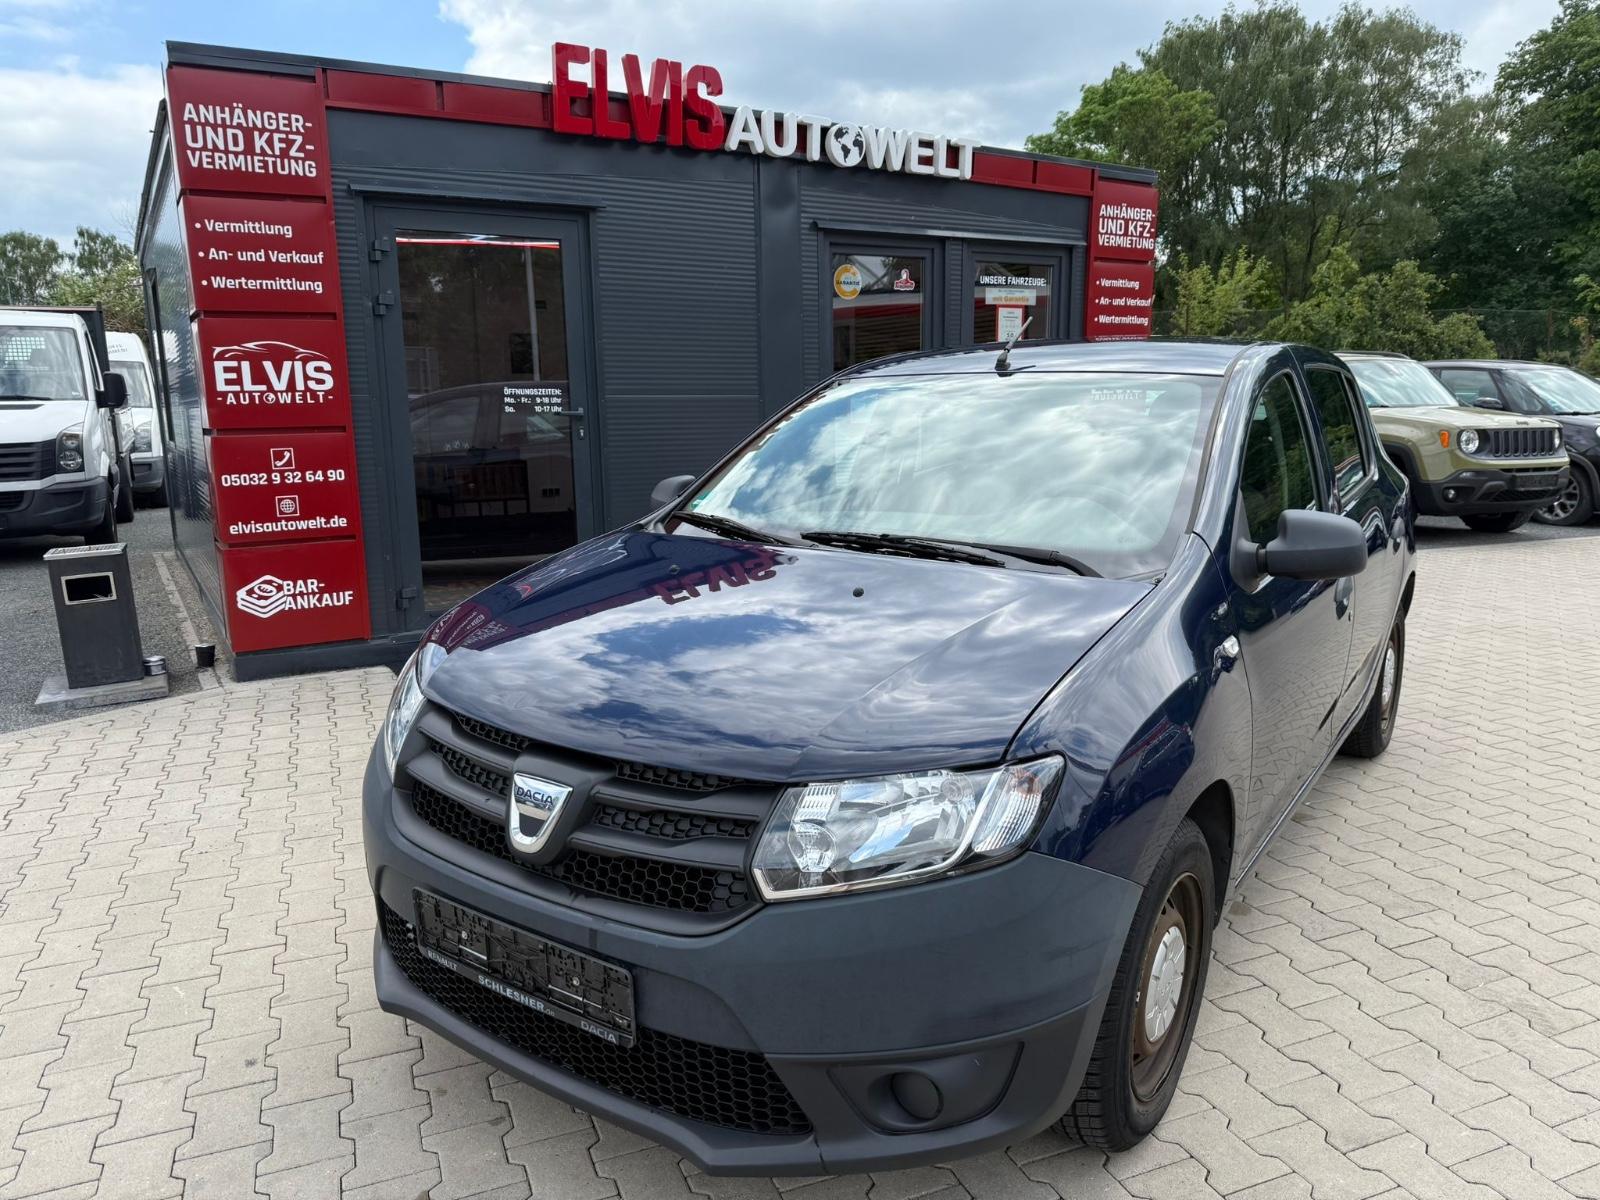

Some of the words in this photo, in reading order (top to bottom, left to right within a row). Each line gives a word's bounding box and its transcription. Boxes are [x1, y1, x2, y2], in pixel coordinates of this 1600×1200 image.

[183, 102, 312, 133] ANHÄNGER-
[552, 41, 725, 151] ELVIS
[724, 105, 981, 182] AUTOWELT
[184, 125, 245, 150] UND
[254, 131, 315, 157] KFZ-
[186, 150, 317, 178] VERMIETUNG
[1099, 203, 1155, 221] ANHÄNGER-
[204, 219, 293, 238] Vermittlung
[1099, 218, 1125, 235] UND
[1128, 221, 1155, 237] KFZ-
[1098, 234, 1154, 250] VERMIETUNG
[208, 247, 234, 260] An-
[238, 248, 265, 262] und
[269, 250, 324, 265] Verkauf
[211, 275, 323, 294] Wertermittlung
[980, 275, 1006, 285] UNSERE
[1100, 278, 1139, 290] Vermittlung
[1099, 296, 1112, 305] An-
[1112, 297, 1125, 306] und
[1126, 297, 1152, 307] Verkauf
[1099, 314, 1149, 326] Wertermittlung
[213, 360, 334, 392] ELVIS
[503, 386, 562, 396] ÖFFNUNGSZEITEN:
[534, 405, 550, 413] 10-17
[221, 473, 268, 487] 05032
[272, 472, 281, 484] 9
[284, 471, 302, 484] 32
[306, 470, 324, 483] 64
[327, 469, 345, 482] 90
[229, 515, 348, 535] elvisautowelt.de
[282, 578, 325, 595] BAR-
[284, 590, 354, 611] ANKAUF
[516, 786, 554, 806] DACIA
[580, 1020, 617, 1044] DACIA
